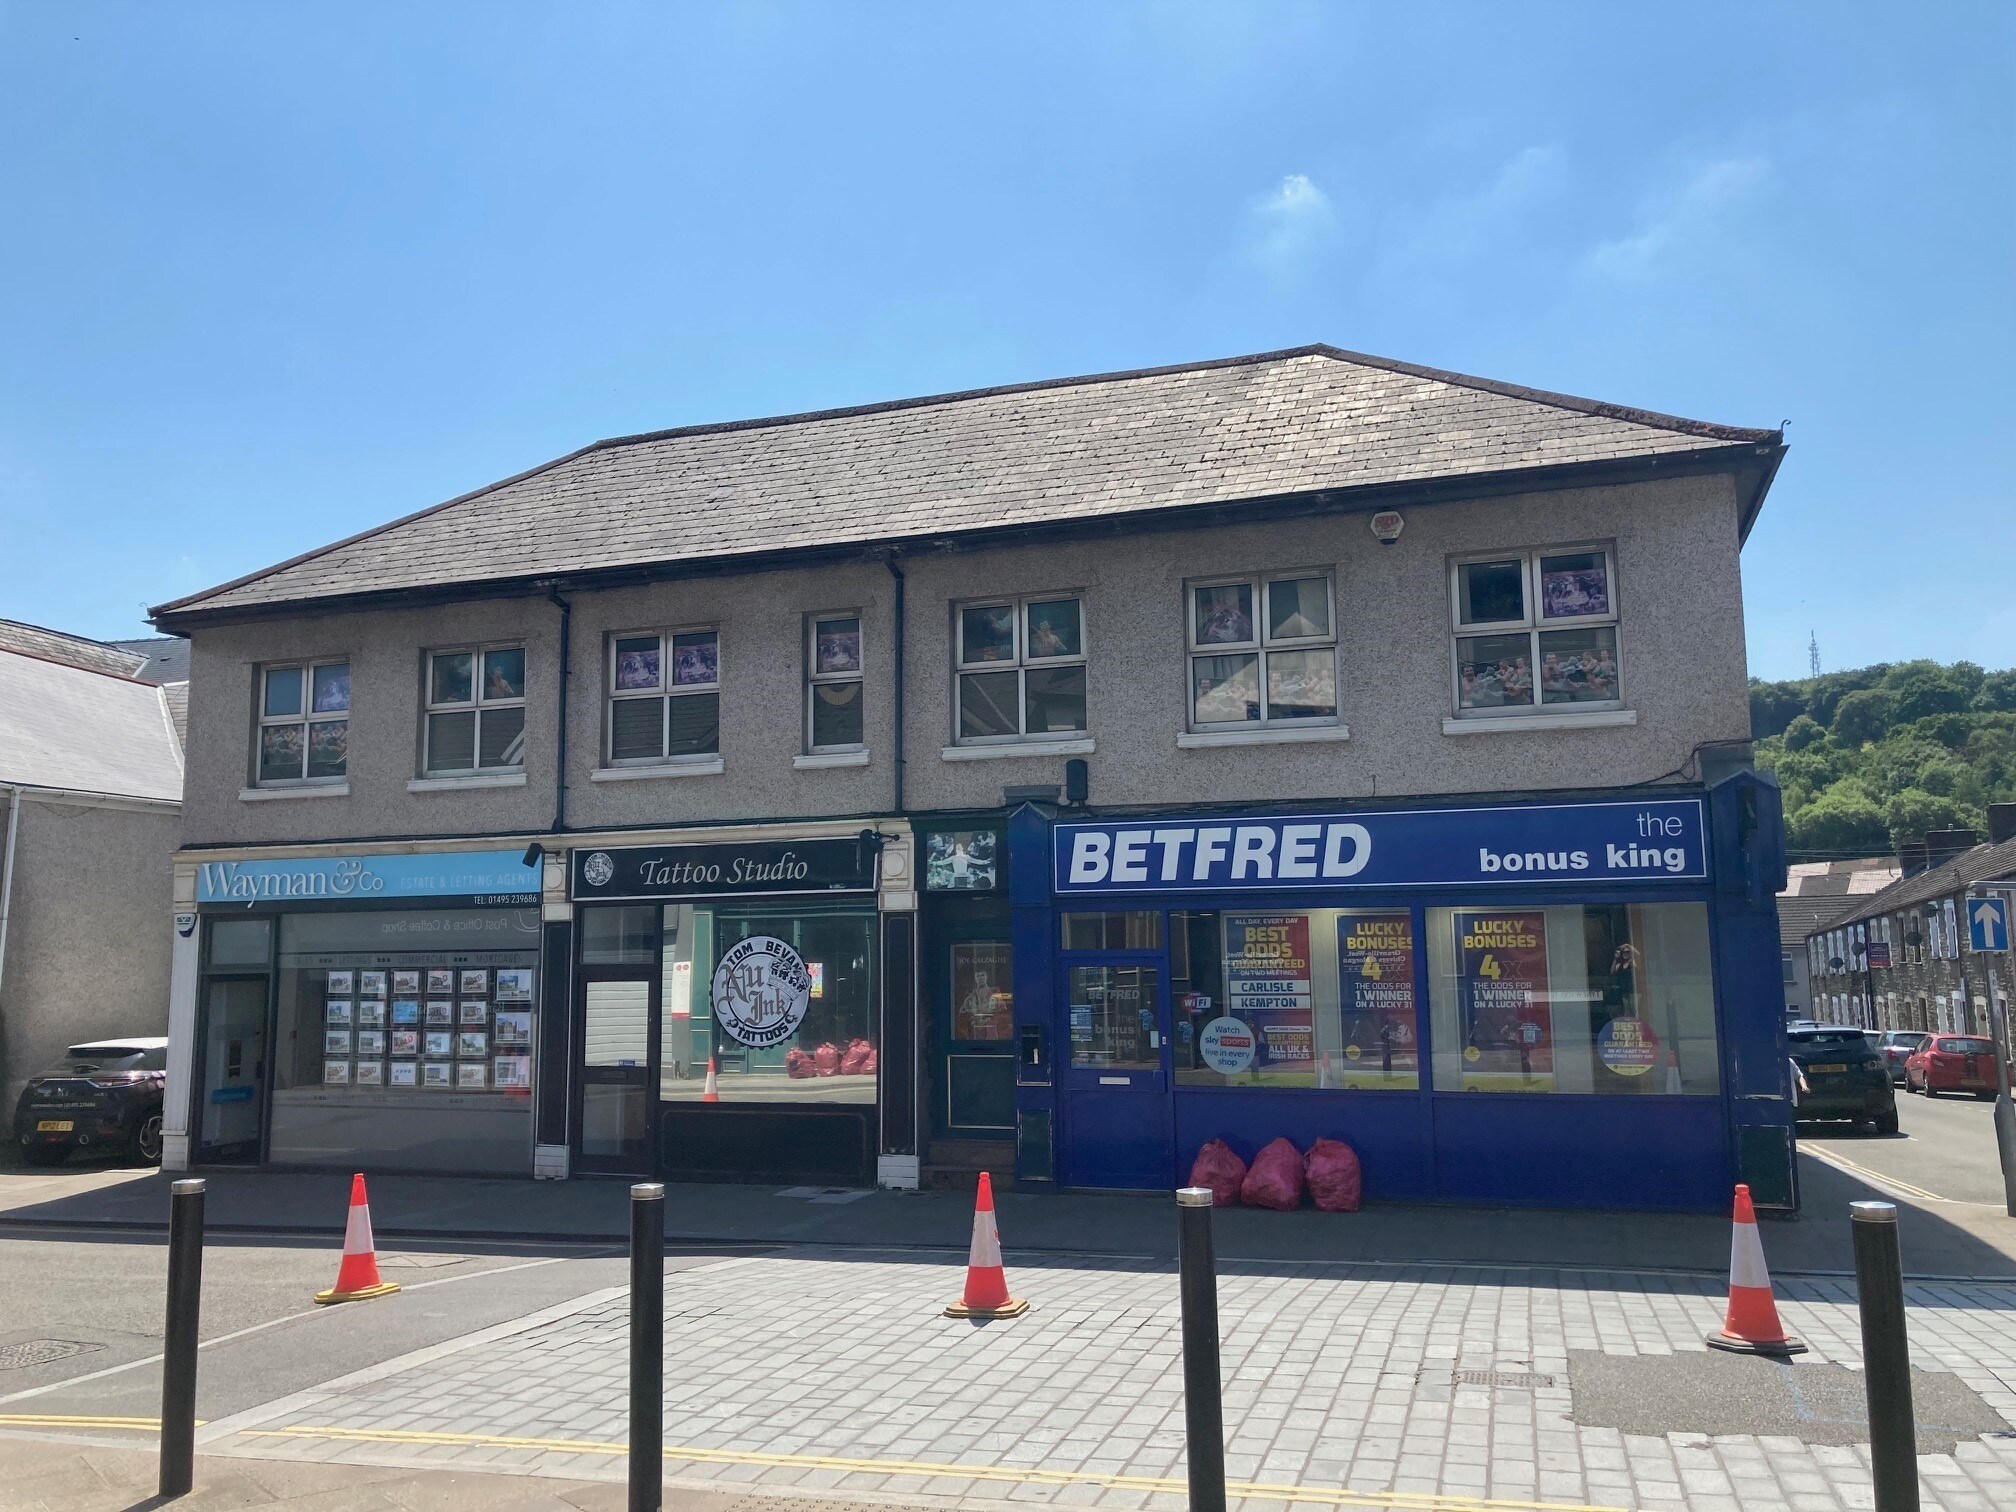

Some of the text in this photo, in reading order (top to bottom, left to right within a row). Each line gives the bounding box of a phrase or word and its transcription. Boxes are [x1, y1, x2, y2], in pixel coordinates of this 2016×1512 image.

[1637, 812, 1683, 836] the
[1069, 824, 1371, 883] BETFRED
[1480, 843, 1685, 872] bonus king
[640, 852, 808, 885] Tattoo Studio
[202, 862, 327, 908] Wayman
[401, 872, 538, 890] ESTATE & LETTING AGENTS
[489, 895, 510, 904] 01495
[511, 894, 537, 903] 239686
[1356, 923, 1404, 935] LUCKY
[1473, 921, 1523, 933] LUCKY
[1245, 927, 1289, 941] BEST
[1464, 935, 1537, 948] BONUSES
[727, 942, 754, 966] TOM
[1244, 943, 1293, 957] ODDS
[1241, 983, 1294, 992] CARLISLE
[1473, 982, 1532, 990] THE ODDS FOR
[1088, 990, 1140, 1000] BETFRED
[1355, 991, 1412, 1001] 1 WINNER
[1474, 990, 1533, 1000] 1 WINNER
[1241, 998, 1297, 1007] KEMPTON
[1525, 1000, 1533, 1008] 31
[737, 1022, 789, 1042] TATTOOS
[1094, 1023, 1135, 1034] bonus
[1214, 1026, 1240, 1034] Watch
[1613, 1022, 1641, 1031] BEST
[1205, 1036, 1249, 1046] sky sports
[1612, 1031, 1642, 1040] ODDS
[1105, 1038, 1136, 1049] king
[1205, 1048, 1250, 1059] live in every
[1287, 1052, 1310, 1060] RACES
[1217, 1058, 1238, 1067] shop
